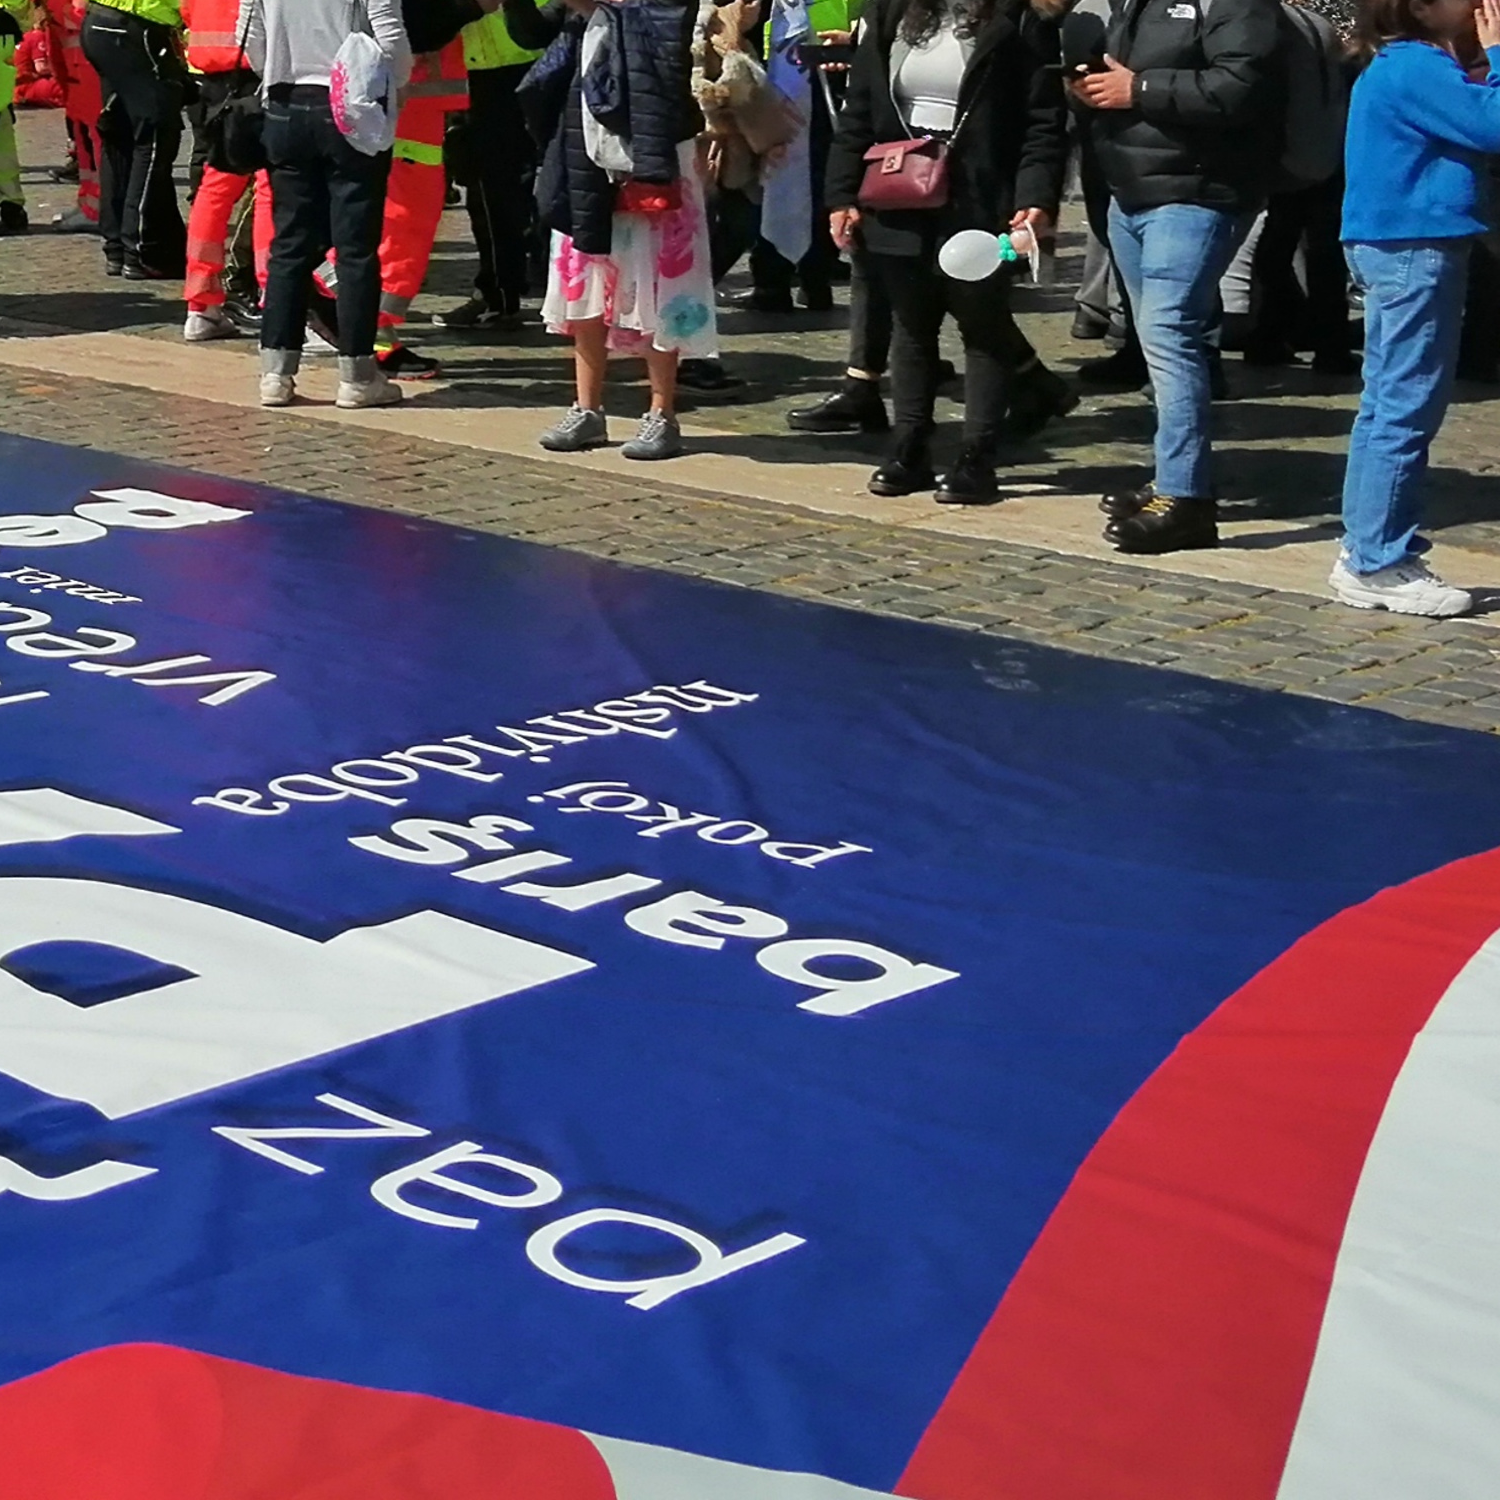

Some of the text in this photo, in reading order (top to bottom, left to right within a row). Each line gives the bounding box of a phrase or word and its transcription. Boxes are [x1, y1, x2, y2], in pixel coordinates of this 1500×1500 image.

[192, 680, 759, 815] mshvidoba
[527, 782, 873, 868] pokój
[211, 1093, 806, 1310] paz
